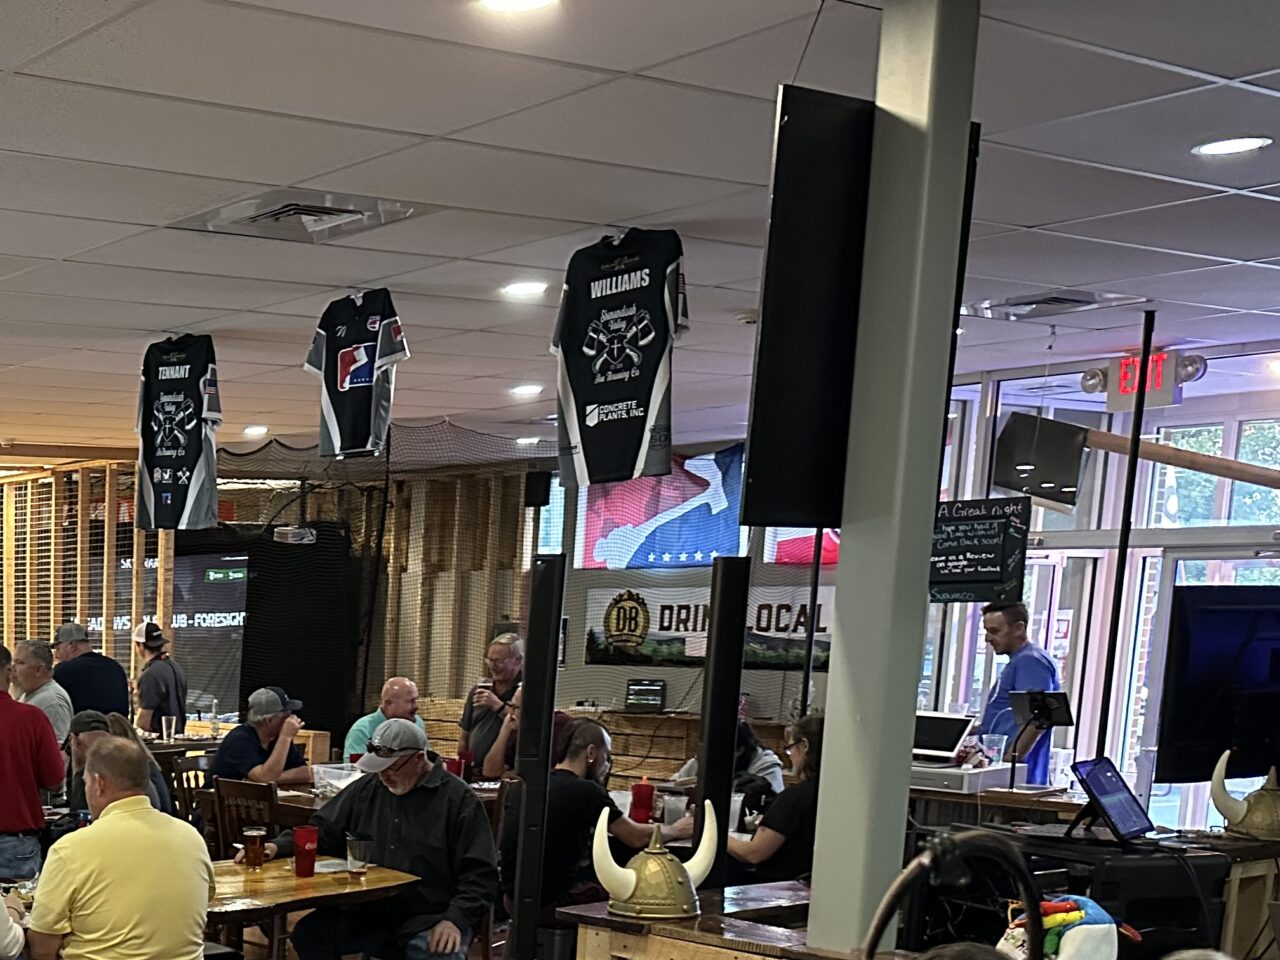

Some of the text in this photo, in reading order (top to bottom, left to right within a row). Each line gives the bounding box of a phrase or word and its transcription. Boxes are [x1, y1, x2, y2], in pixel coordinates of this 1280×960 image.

[590, 268, 650, 299] WILLIAMS
[158, 364, 191, 380] TENNANT
[599, 400, 638, 414] CONCRETE
[629, 407, 645, 417] INC
[938, 502, 1023, 517] A Great night
